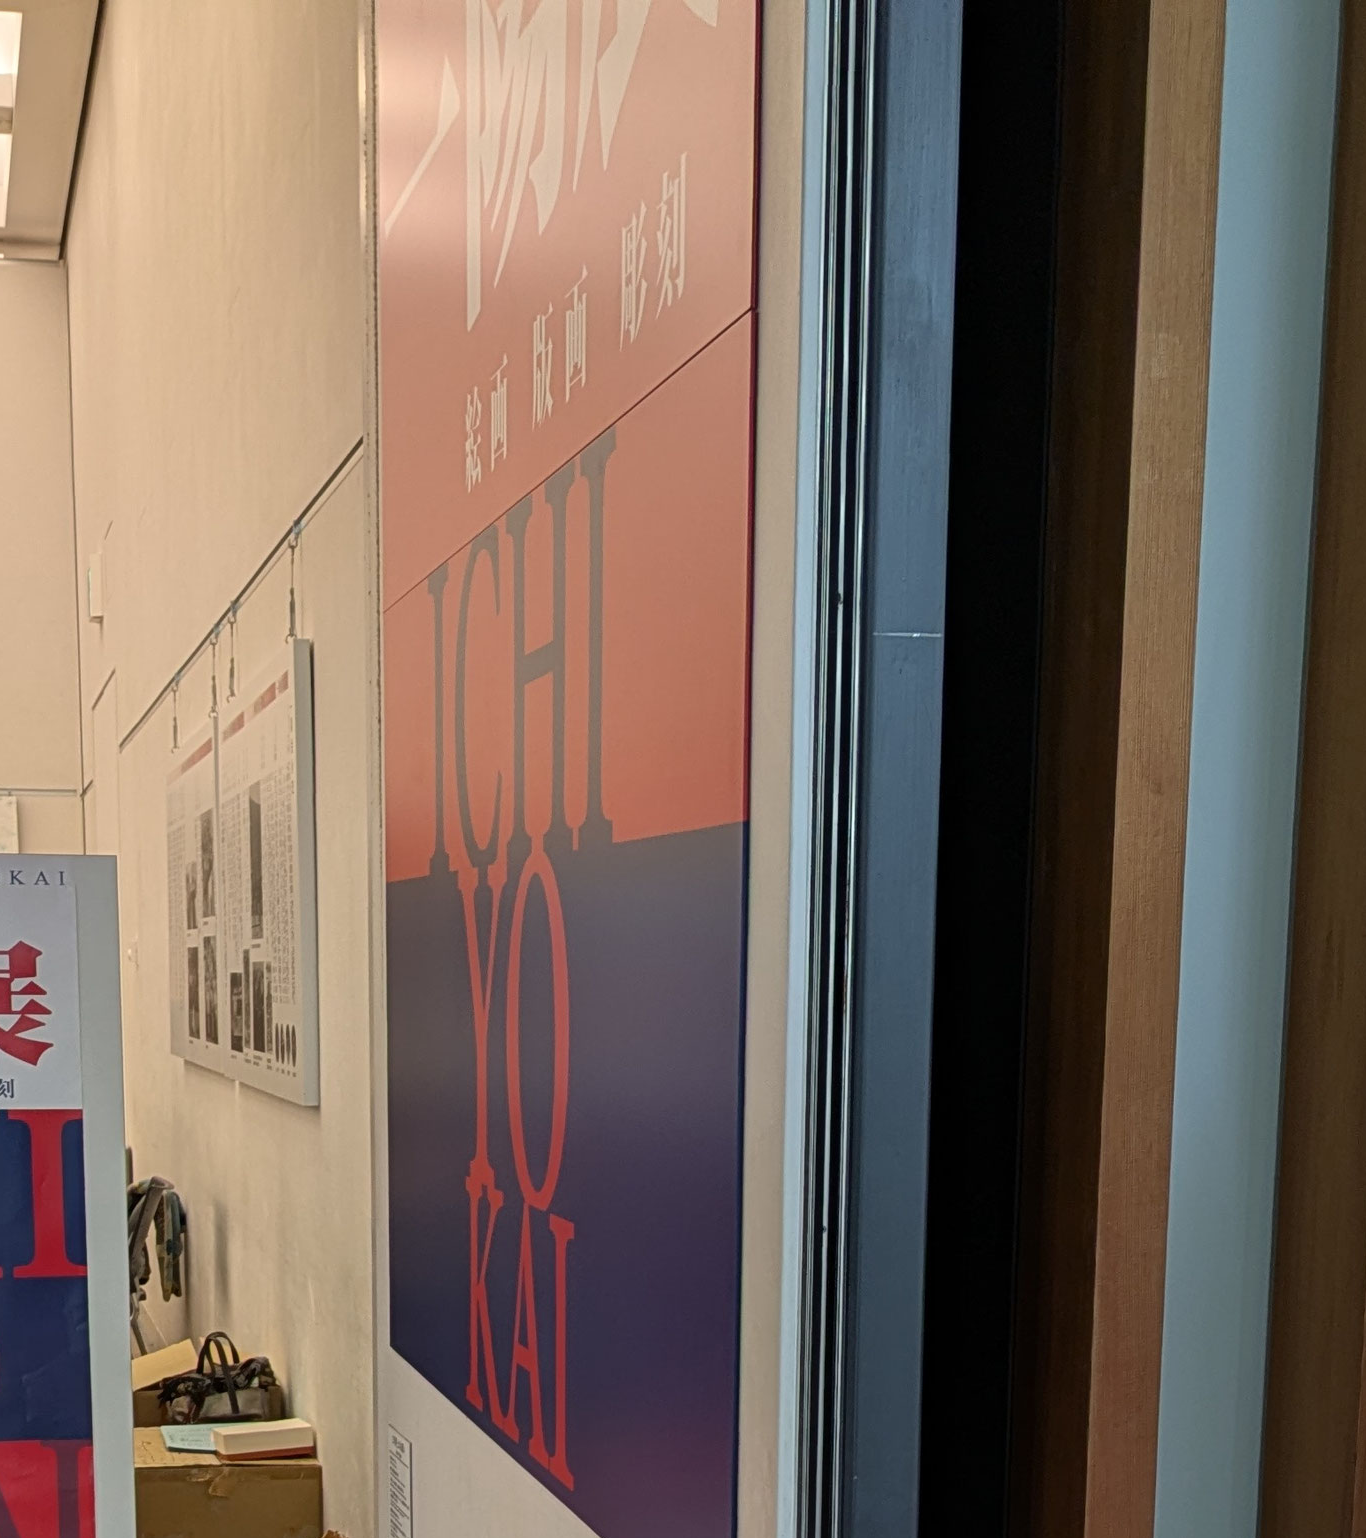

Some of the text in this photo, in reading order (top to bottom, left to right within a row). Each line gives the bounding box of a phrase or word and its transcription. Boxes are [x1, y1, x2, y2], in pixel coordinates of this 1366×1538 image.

[464, 152, 689, 494] 絵画 版画 彫刻
[427, 426, 617, 878] ICHI
[456, 851, 572, 1211] YO
[465, 1177, 576, 1493] KAI
